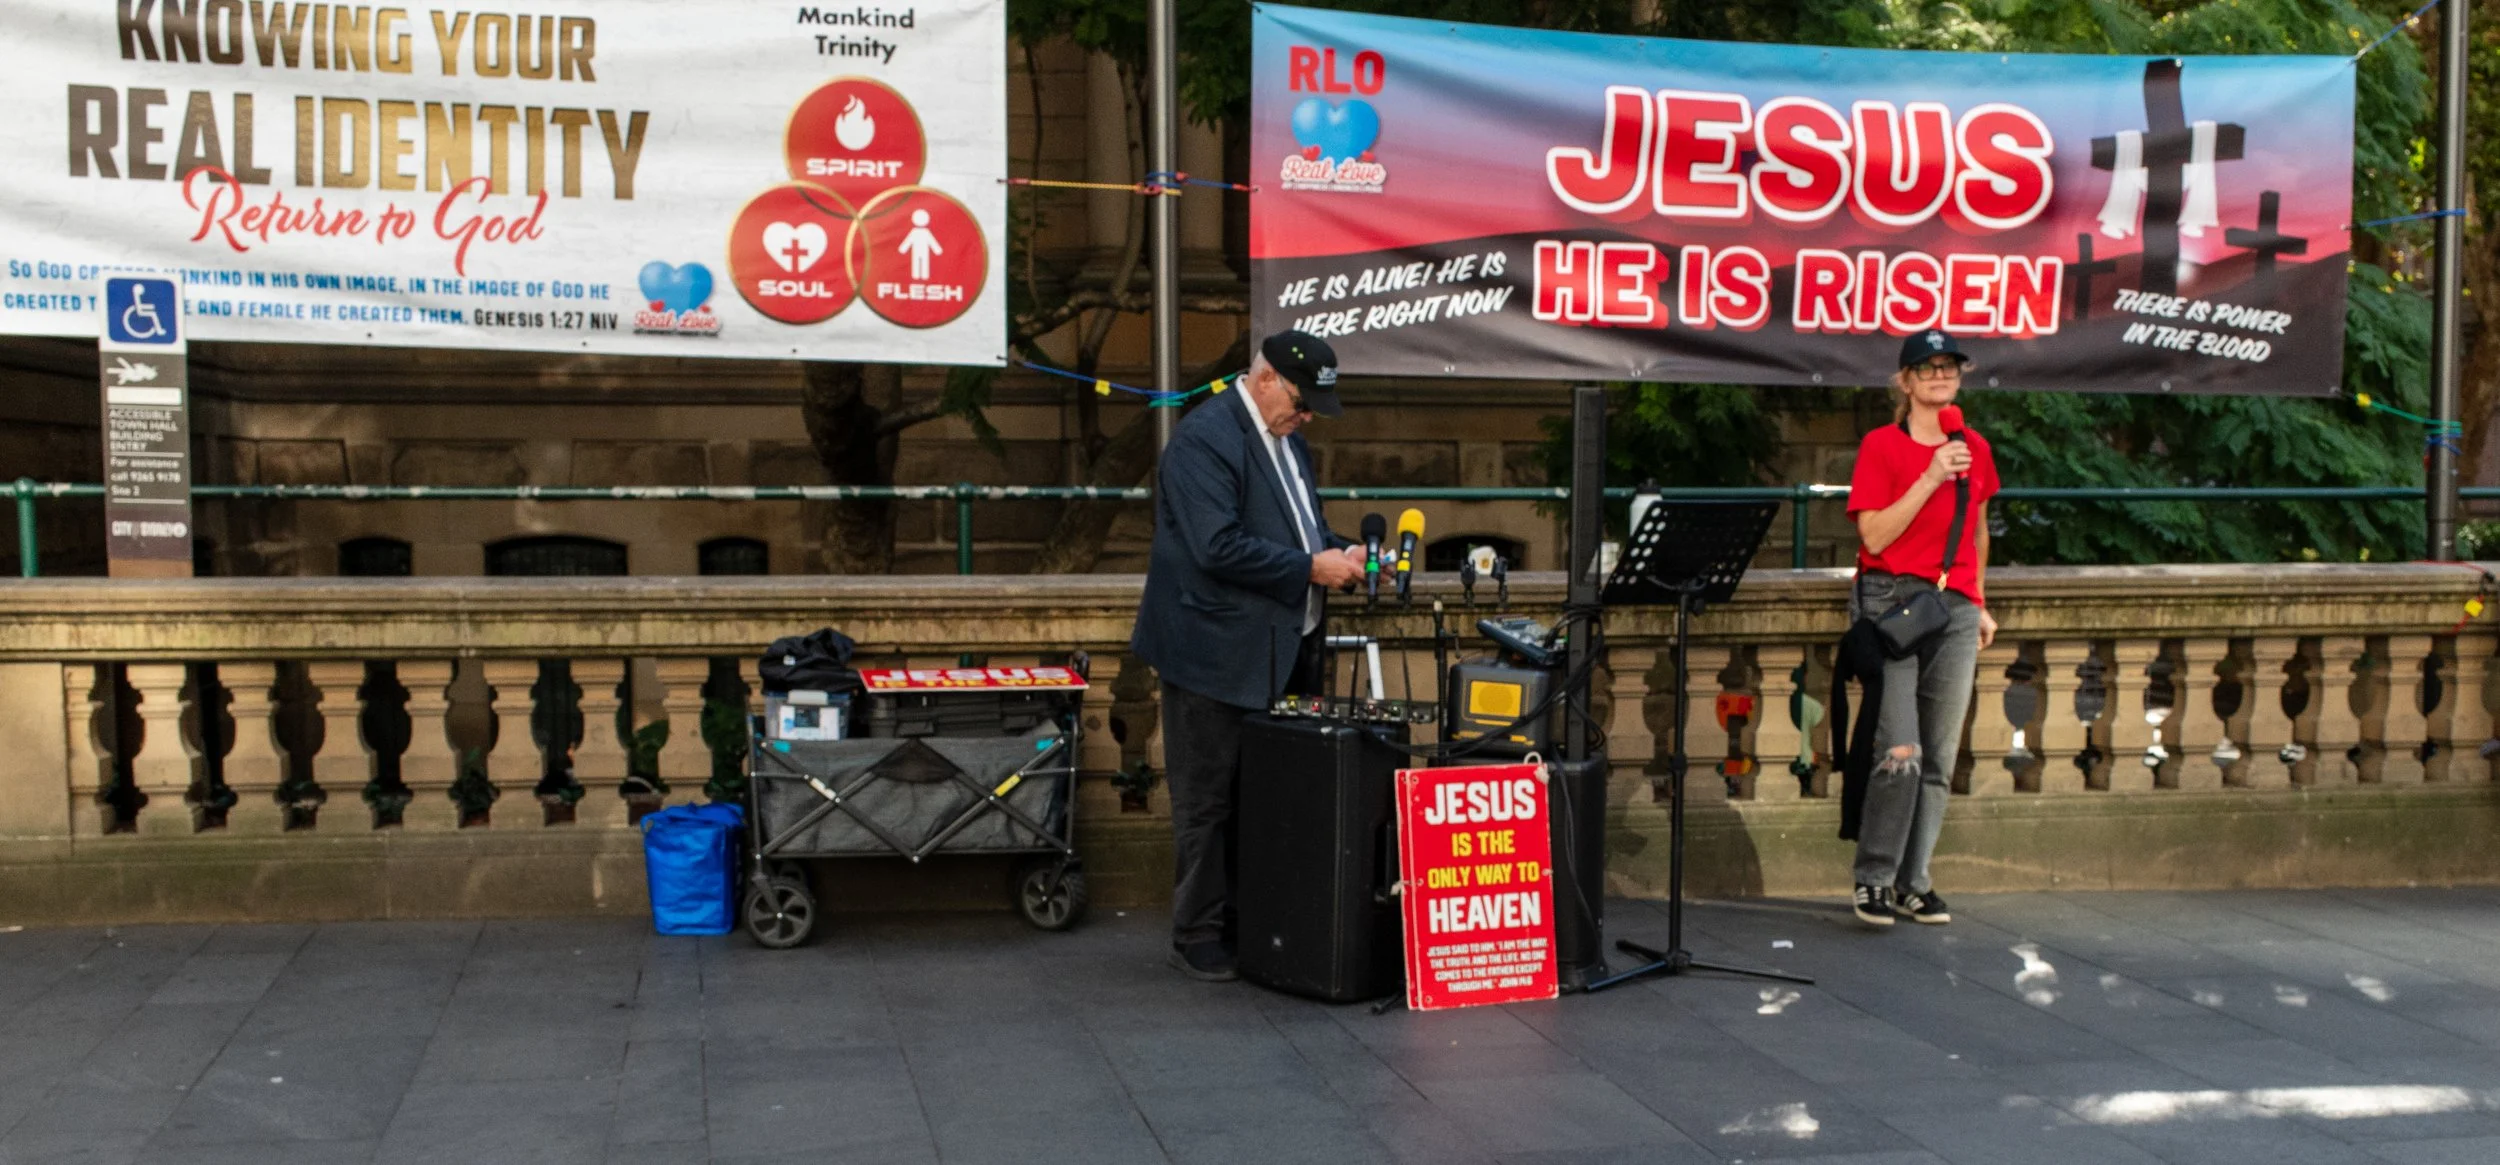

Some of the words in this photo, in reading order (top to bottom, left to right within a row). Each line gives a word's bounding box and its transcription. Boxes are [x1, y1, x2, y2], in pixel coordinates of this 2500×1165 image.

[798, 7, 915, 29] Mankind
[117, 0, 412, 75] KNOWING
[429, 10, 597, 83] YOUR
[816, 35, 897, 64] Trinity
[1288, 46, 1385, 96] RLO
[67, 83, 271, 186] REAL
[293, 95, 651, 201] IDENTITY
[805, 157, 904, 178] SPIRIT
[1281, 154, 1335, 183] Real
[1335, 156, 1387, 185] Love
[1546, 86, 2055, 230] JESUS
[182, 165, 370, 254] Return
[375, 202, 416, 245] to
[434, 177, 548, 277] God
[249, 273, 265, 288] IN
[272, 273, 299, 289] HIS
[306, 274, 340, 290] OWN
[346, 275, 403, 294] IMAGE,
[409, 278, 426, 293] IN
[434, 279, 463, 295] THE
[469, 279, 520, 298] IMAGE
[526, 281, 545, 299] OF
[589, 283, 611, 300] HE
[758, 280, 834, 298] SOUL
[877, 282, 964, 302] FLESH
[1278, 276, 1320, 308] HE
[1322, 273, 1350, 301] IS
[1352, 261, 1435, 297] ALIVE!
[1436, 253, 1479, 283] HE
[1480, 250, 1507, 277] IS
[1533, 240, 1664, 326] HE
[1679, 245, 1772, 329] IS
[1792, 249, 2064, 335] RISEN
[5, 292, 83, 311] CREATED
[198, 300, 232, 317] AND
[238, 302, 305, 319] FEMALE
[311, 304, 332, 320] HE
[338, 304, 413, 322] CREATED
[420, 307, 469, 325] THEM.
[550, 311, 584, 330] 1:27
[590, 312, 618, 331] NIV
[1363, 294, 1449, 332] RIGHT
[1445, 285, 1514, 318] NOW
[2113, 288, 2187, 318] THERE
[2185, 299, 2211, 324] IS
[2211, 303, 2292, 335] POWER
[2122, 321, 2151, 344] IN
[2152, 325, 2199, 352] THE
[2196, 331, 2272, 363] BLOOD
[109, 409, 172, 420] ACCESSIBLE
[110, 419, 148, 430] TOWN
[148, 420, 179, 431] HALL
[109, 430, 164, 442] BUILDING
[110, 440, 147, 452] ENTRY
[871, 668, 1072, 681] JESUS
[1425, 779, 1536, 825] JESUS
[1452, 833, 1472, 857] IS
[1477, 830, 1516, 855] THE
[1428, 866, 1471, 889] ONLY
[1475, 863, 1513, 886] WAY
[1517, 861, 1540, 883] TO
[1428, 891, 1541, 934] HEAVEN
